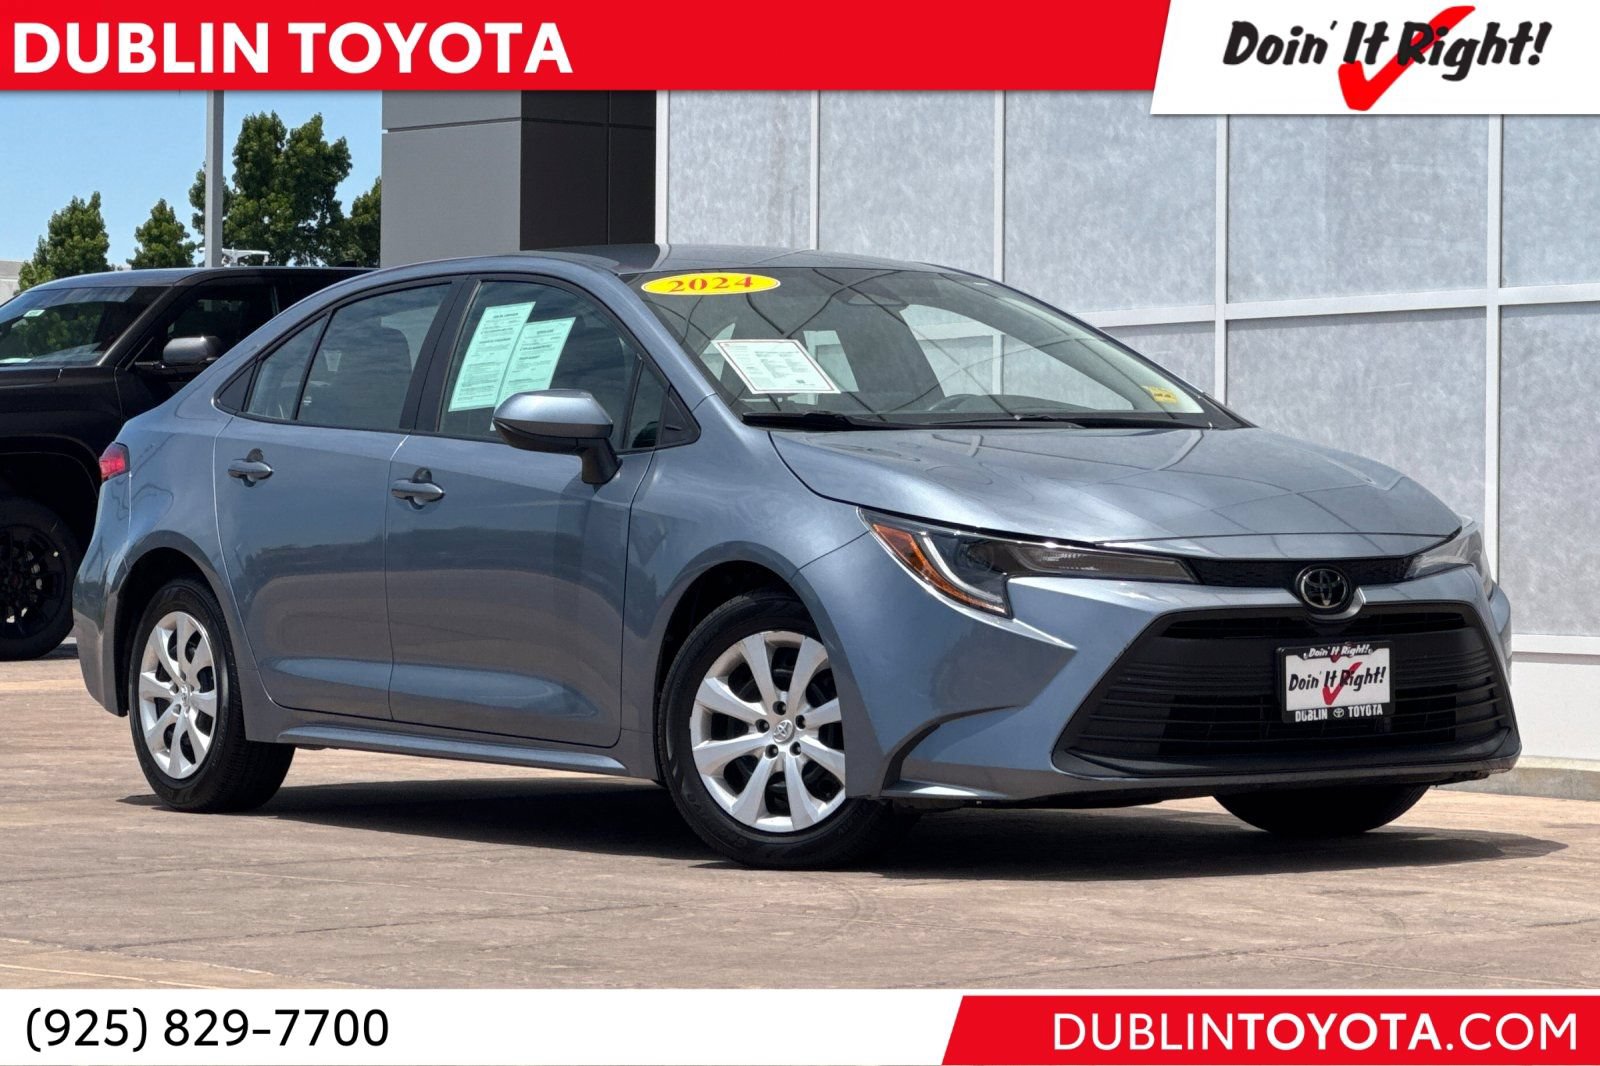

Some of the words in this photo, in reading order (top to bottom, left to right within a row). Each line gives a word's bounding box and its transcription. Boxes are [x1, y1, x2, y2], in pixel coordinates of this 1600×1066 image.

[668, 276, 754, 293] 2024
[1308, 646, 1331, 658] Doin'
[1330, 646, 1341, 656] It
[1341, 644, 1370, 657] Right!
[1288, 671, 1323, 692] Doin'
[1324, 670, 1338, 688] It
[1340, 666, 1387, 692] Right!
[1295, 708, 1329, 723] DUBLIN
[1347, 704, 1384, 718] TOYOTA
